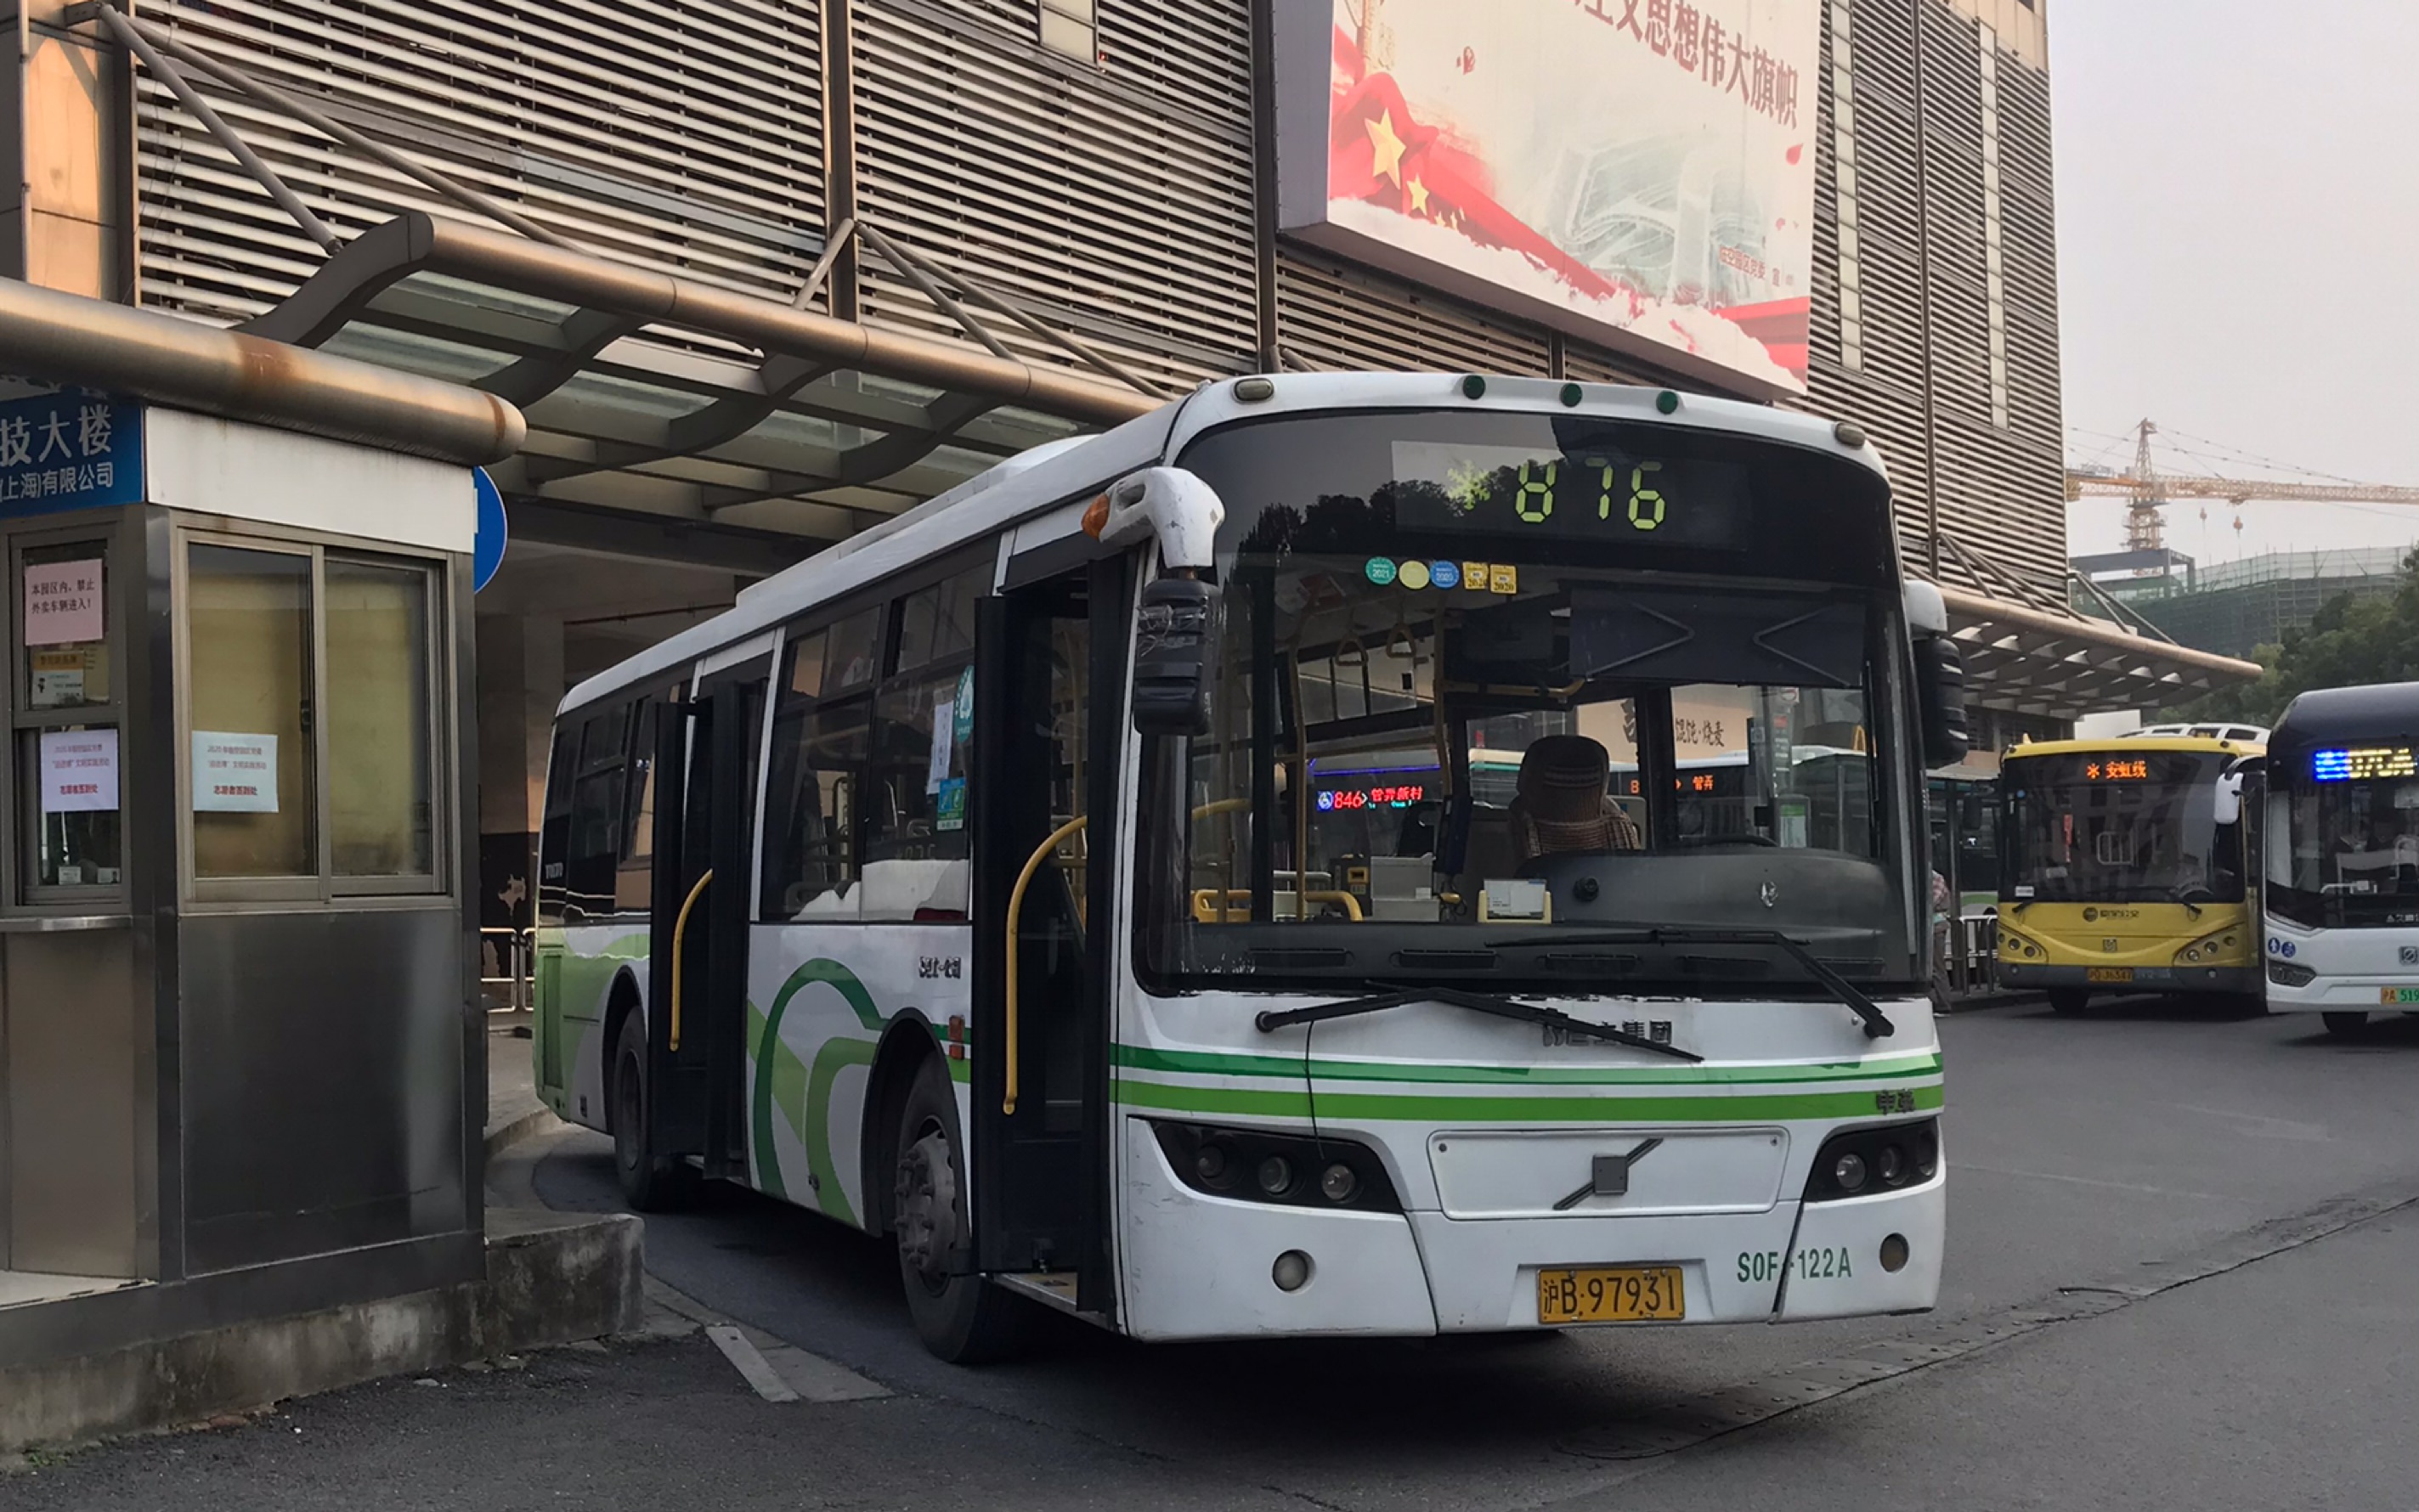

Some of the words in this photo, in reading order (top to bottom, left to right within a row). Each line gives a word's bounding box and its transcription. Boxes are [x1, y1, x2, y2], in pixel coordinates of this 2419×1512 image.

[0, 403, 112, 467] 技大楼
[1333, 791, 1361, 809] 846
